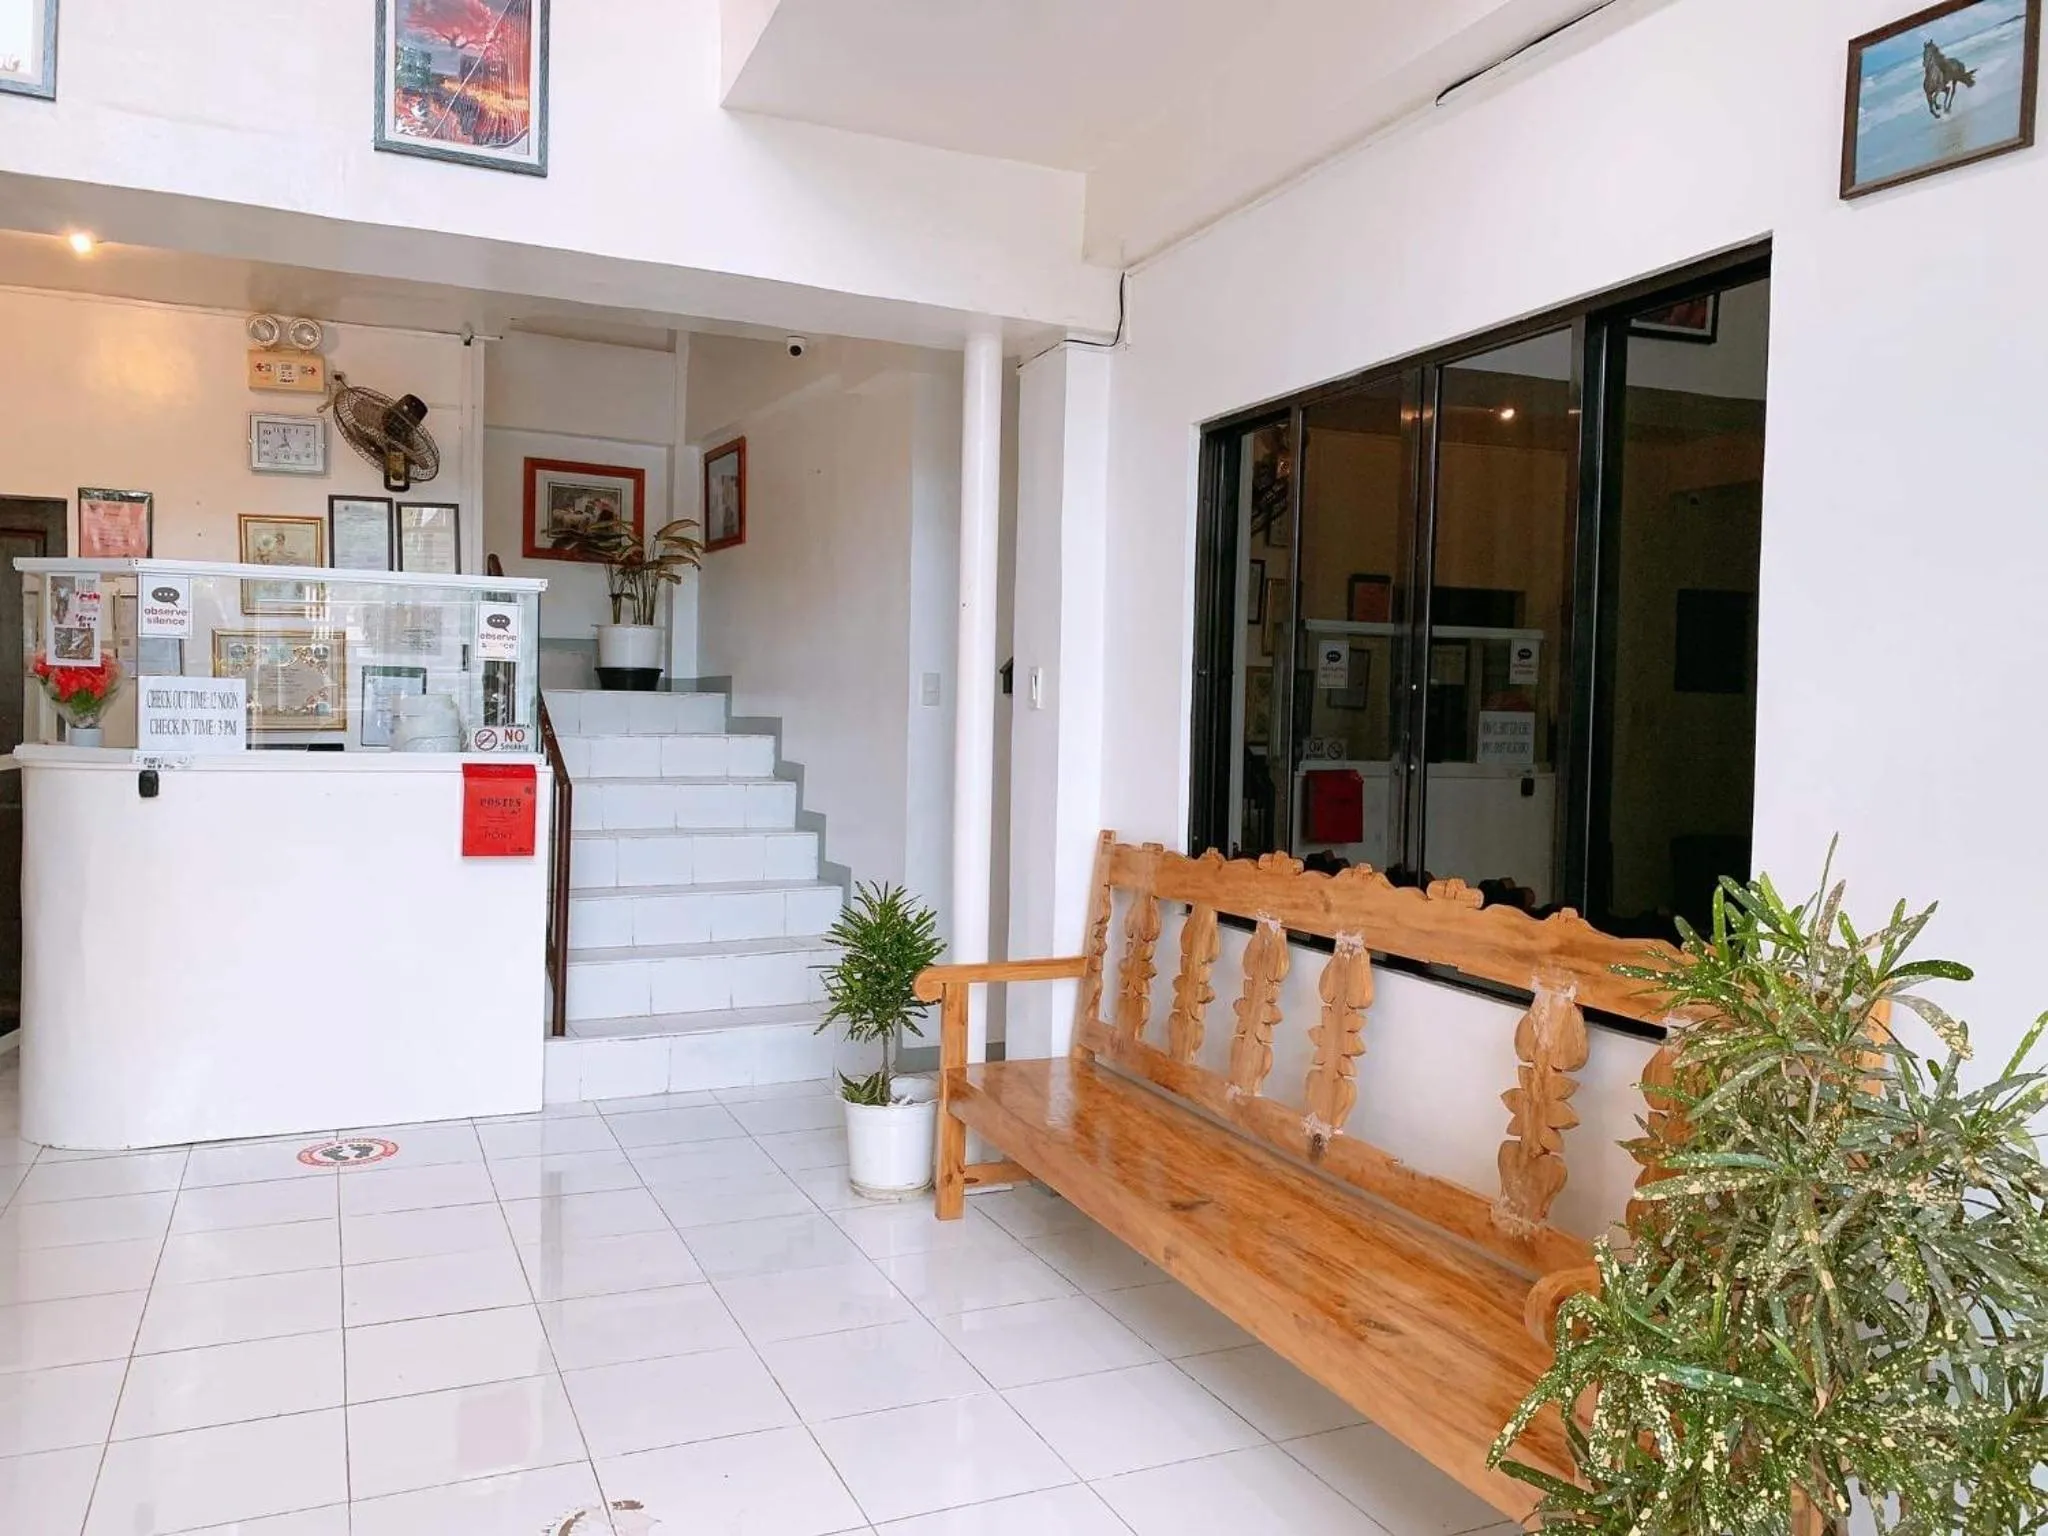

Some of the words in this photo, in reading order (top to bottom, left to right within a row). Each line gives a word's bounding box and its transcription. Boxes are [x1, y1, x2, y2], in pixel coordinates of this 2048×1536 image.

[144, 607, 188, 616] observe
[147, 616, 185, 626] silence
[149, 718, 180, 736] CHECK
[181, 719, 192, 736] IN
[223, 719, 237, 737] PM
[504, 728, 526, 743] NO
